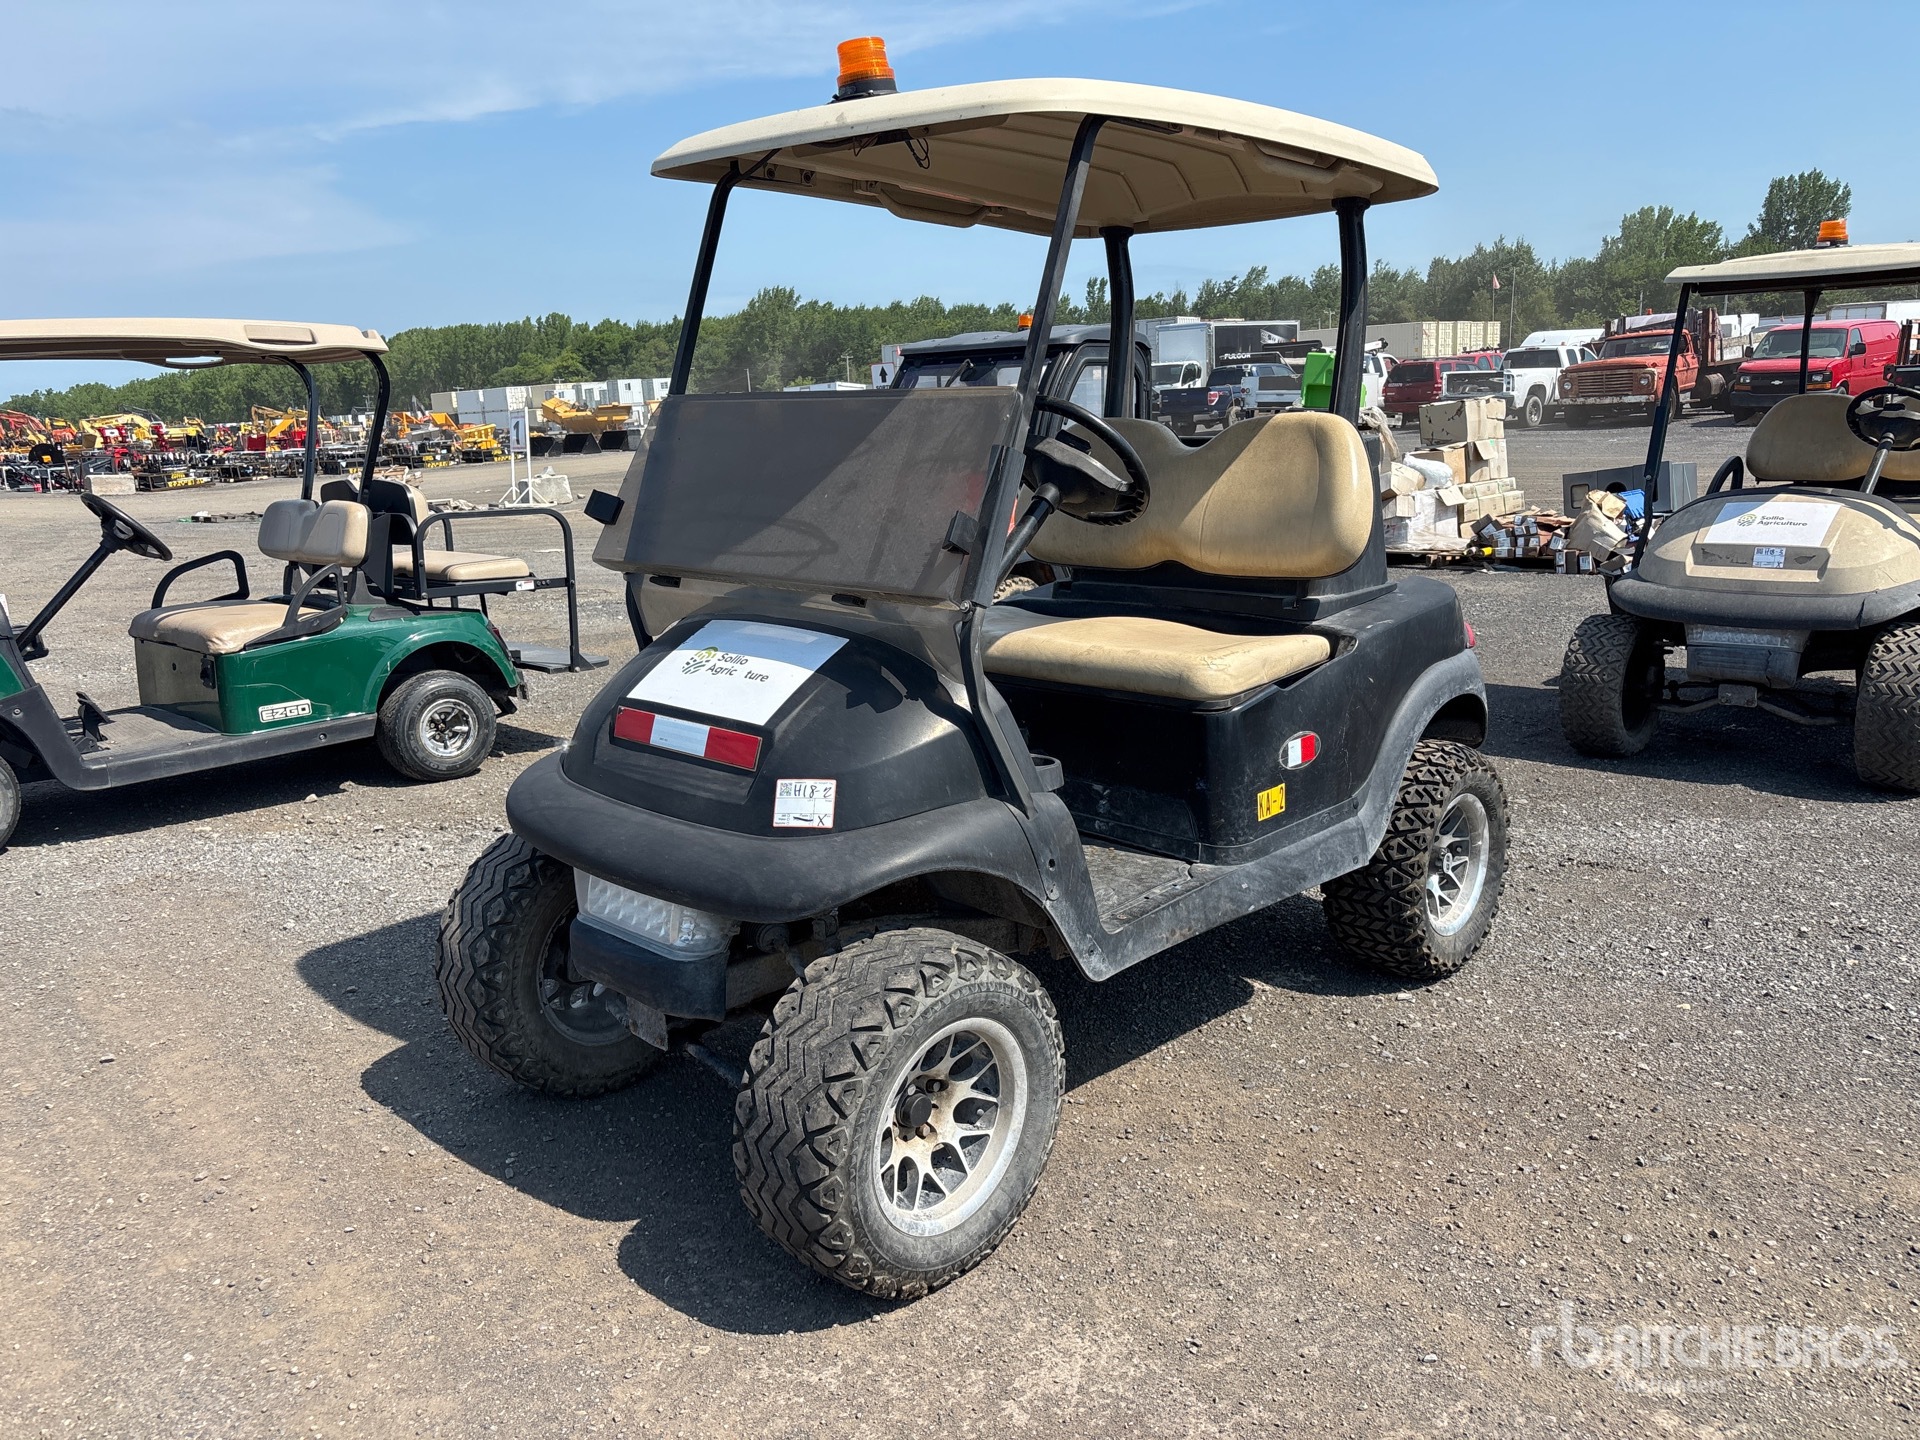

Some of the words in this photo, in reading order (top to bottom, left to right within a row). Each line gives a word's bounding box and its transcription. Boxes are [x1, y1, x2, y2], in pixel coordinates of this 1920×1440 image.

[513, 420, 520, 446] 1
[717, 652, 749, 666] Sollio
[1258, 785, 1284, 819] KA-2
